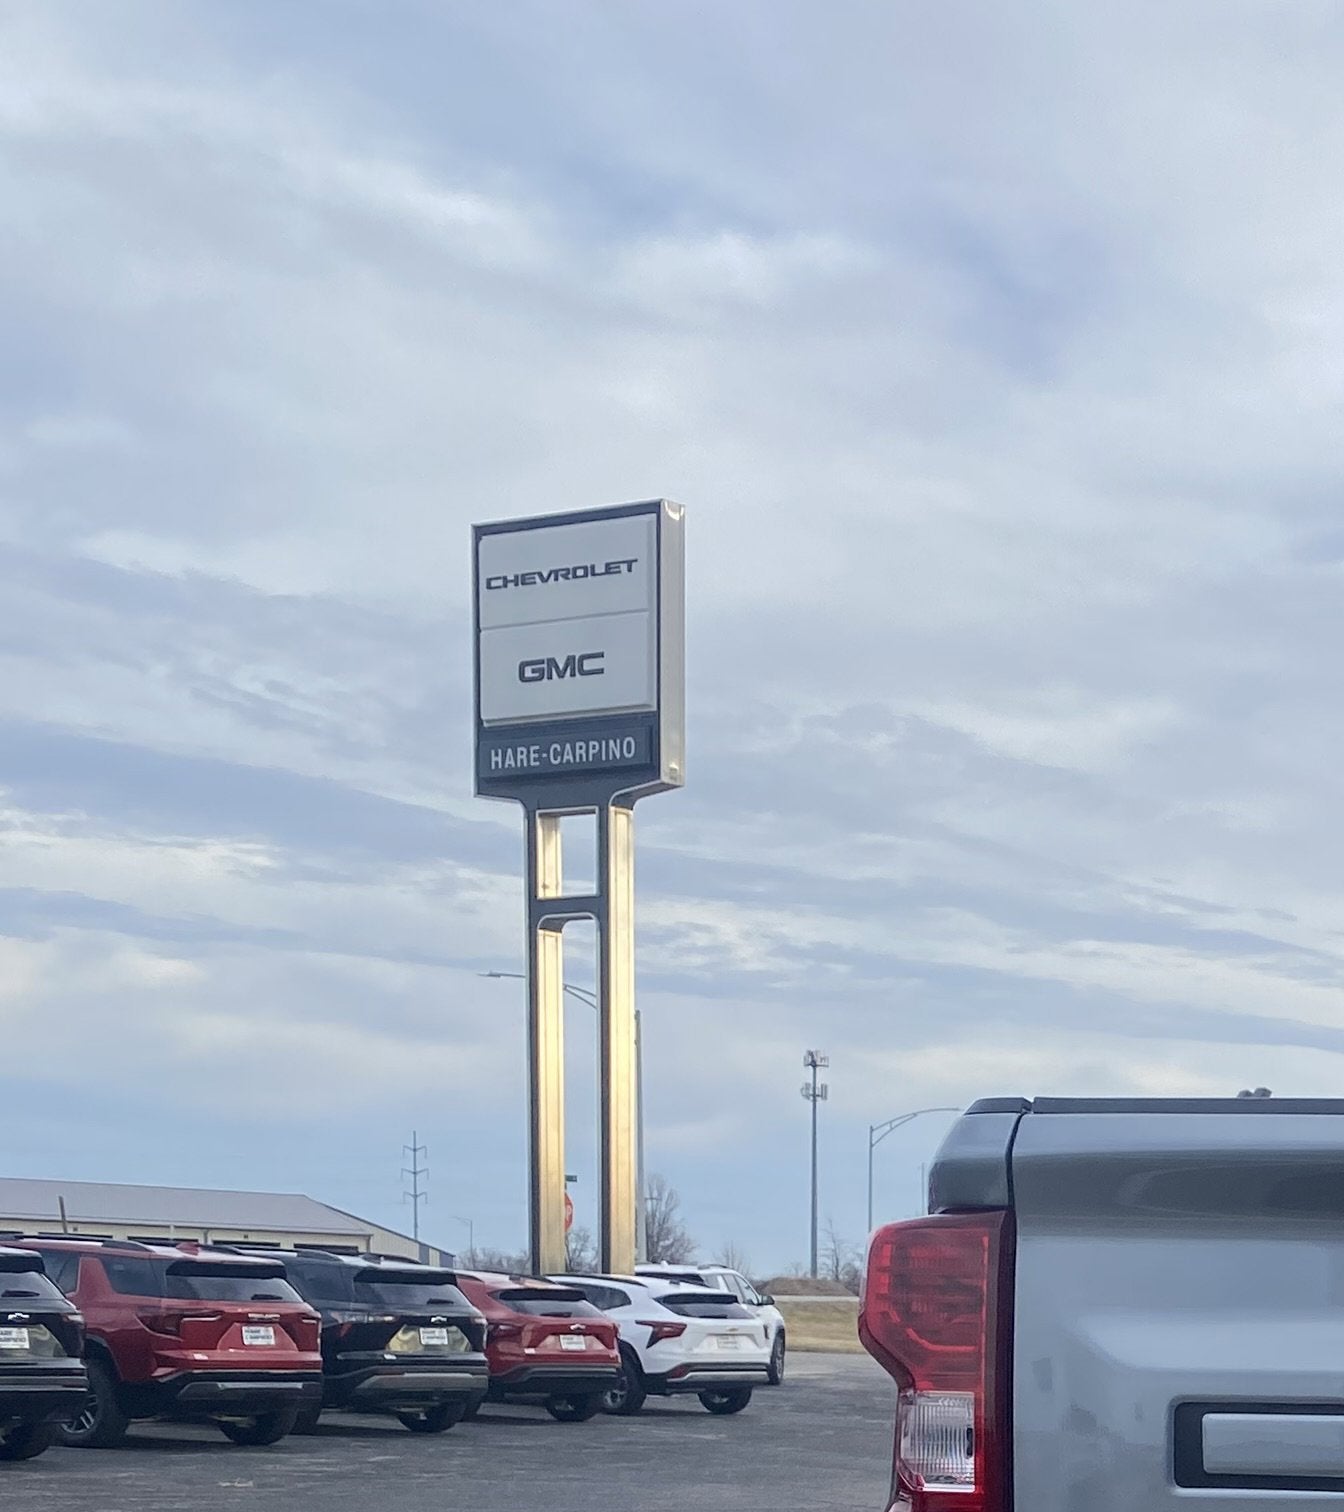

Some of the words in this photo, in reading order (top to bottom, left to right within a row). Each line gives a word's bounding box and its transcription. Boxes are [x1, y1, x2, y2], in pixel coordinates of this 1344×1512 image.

[485, 558, 639, 590] CHEVROLET
[518, 650, 605, 683] GMC
[490, 736, 637, 770] HARE-CARPINO
